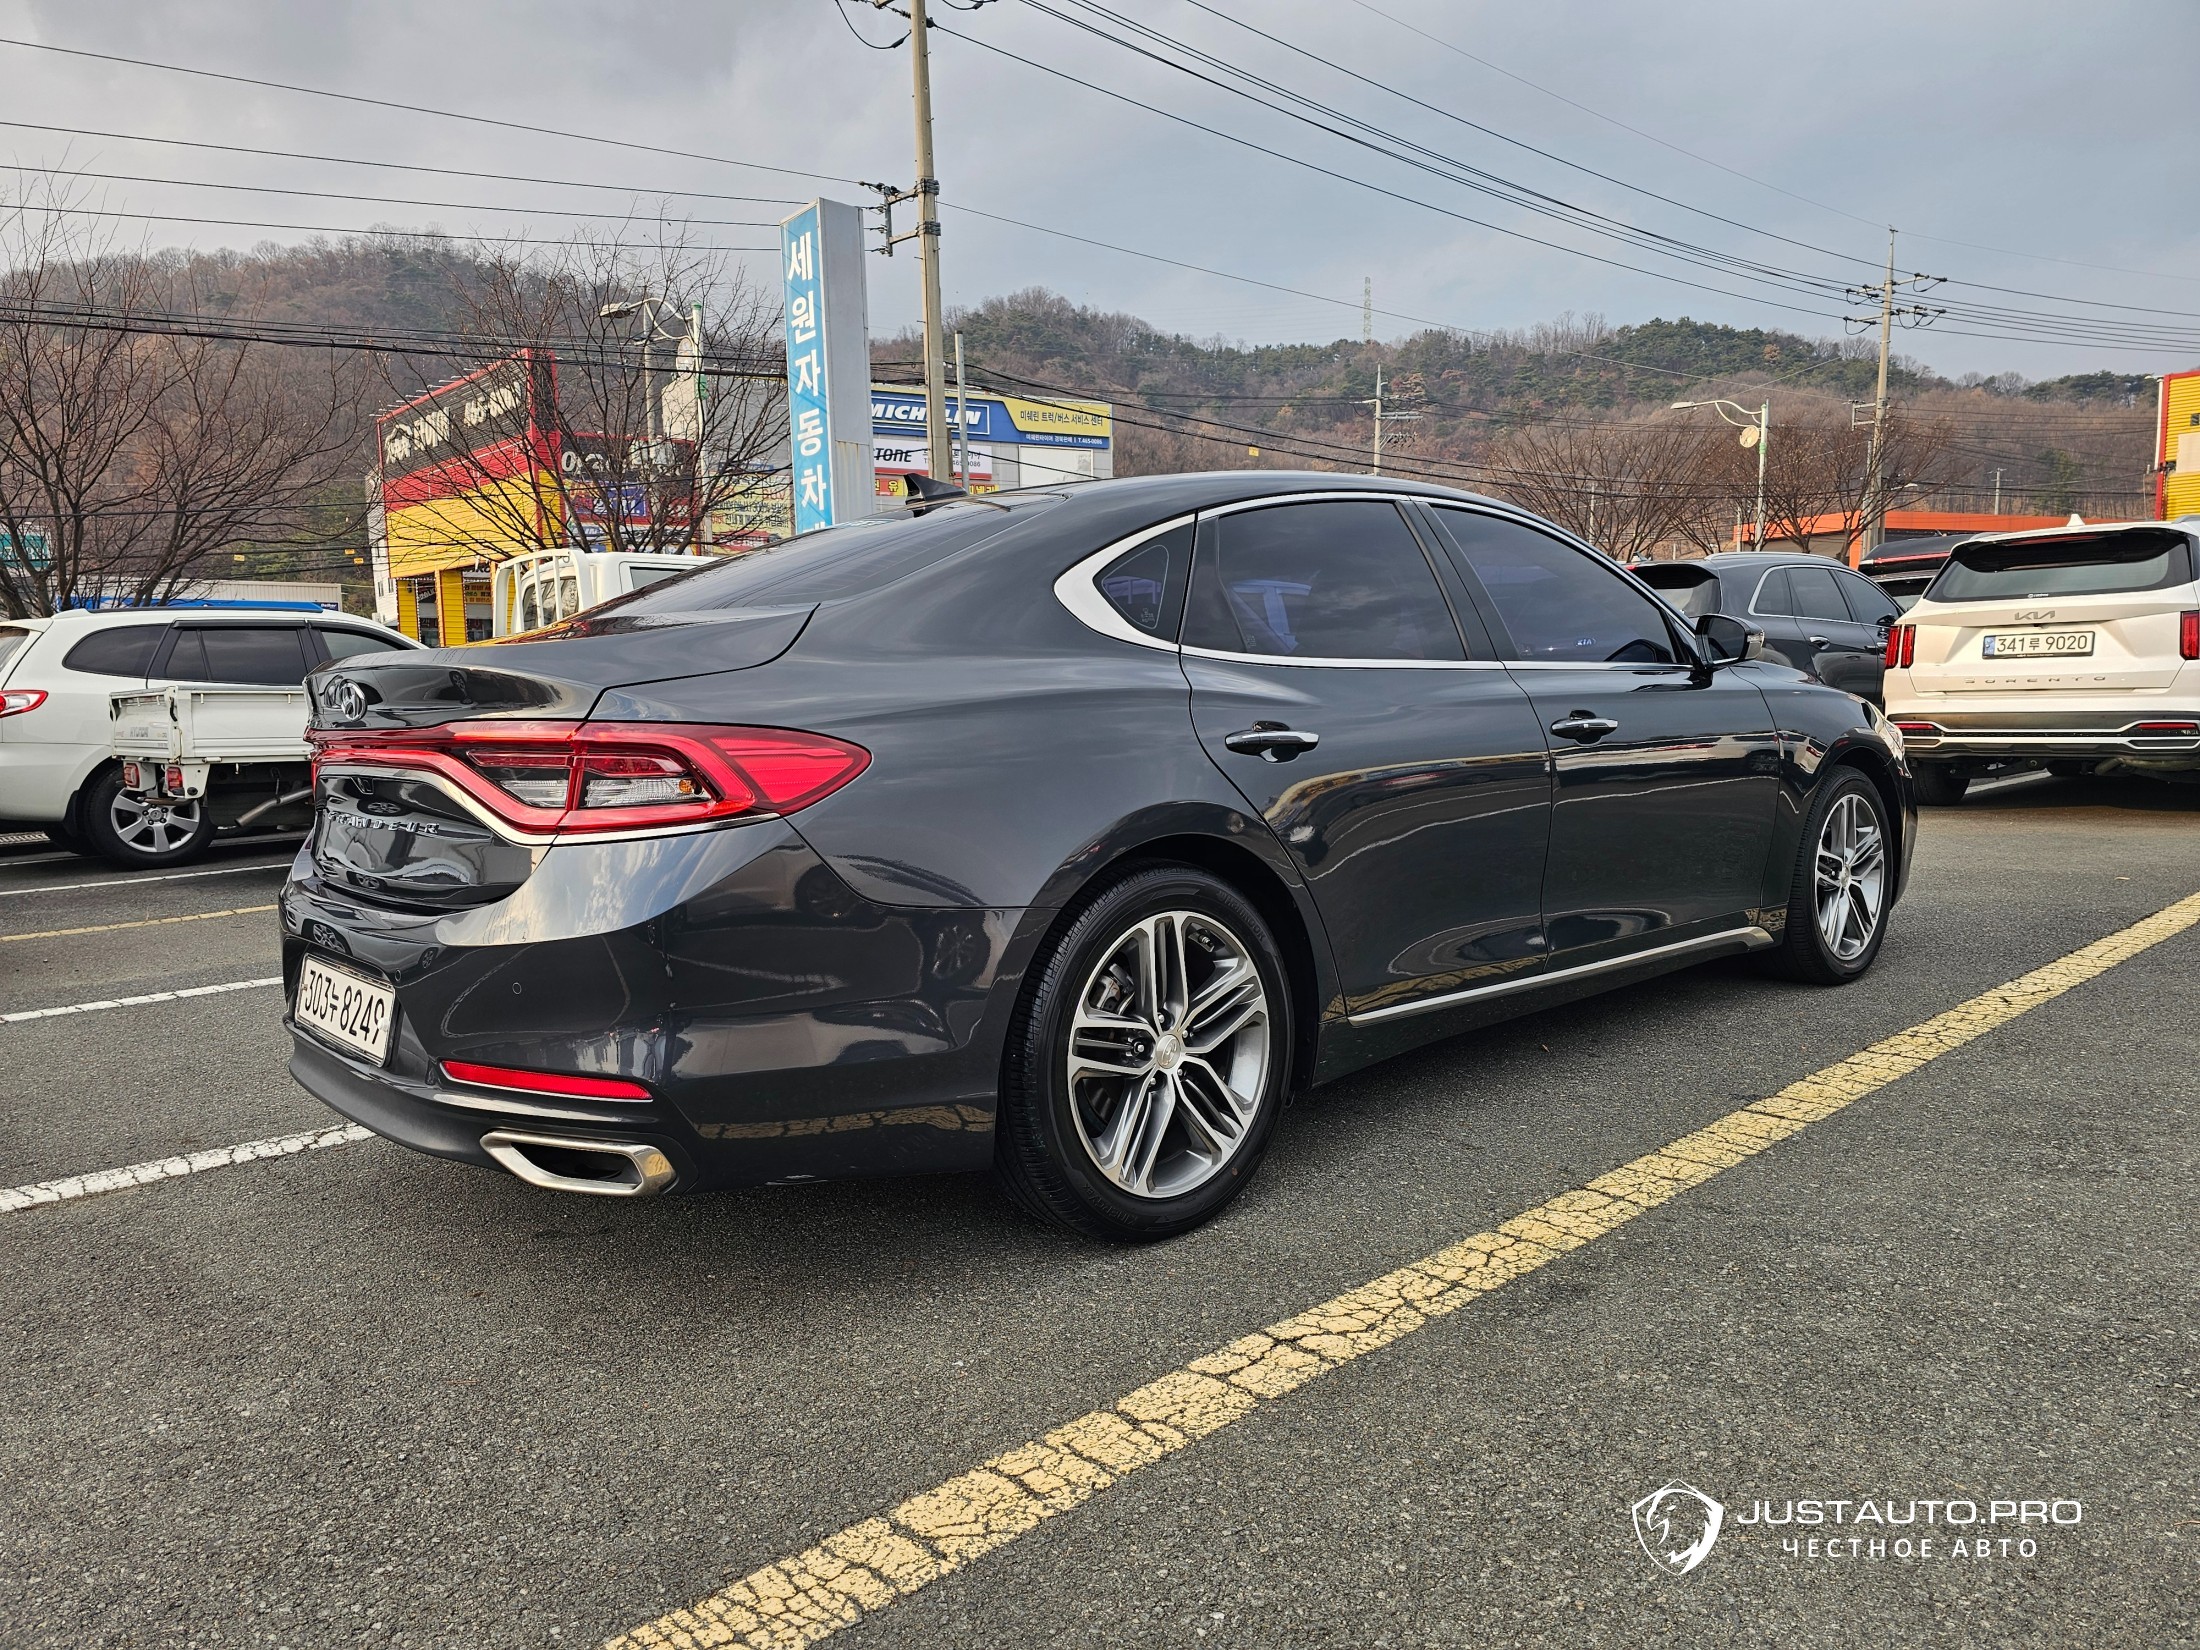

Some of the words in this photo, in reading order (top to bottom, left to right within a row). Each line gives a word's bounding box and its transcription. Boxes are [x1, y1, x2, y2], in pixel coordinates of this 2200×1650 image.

[788, 231, 827, 532] 세원자동차
[871, 403, 981, 425] MICHLIN
[1020, 410, 1039, 422] 미쉐린
[1041, 412, 1070, 424] 트럭/버스
[1071, 414, 1090, 425] 서비스
[1091, 415, 1103, 426] 센터
[2014, 610, 2056, 621] KIA
[1996, 637, 2040, 652] 341루
[2045, 635, 2088, 651] 9020
[1964, 676, 2106, 684] SORENTO
